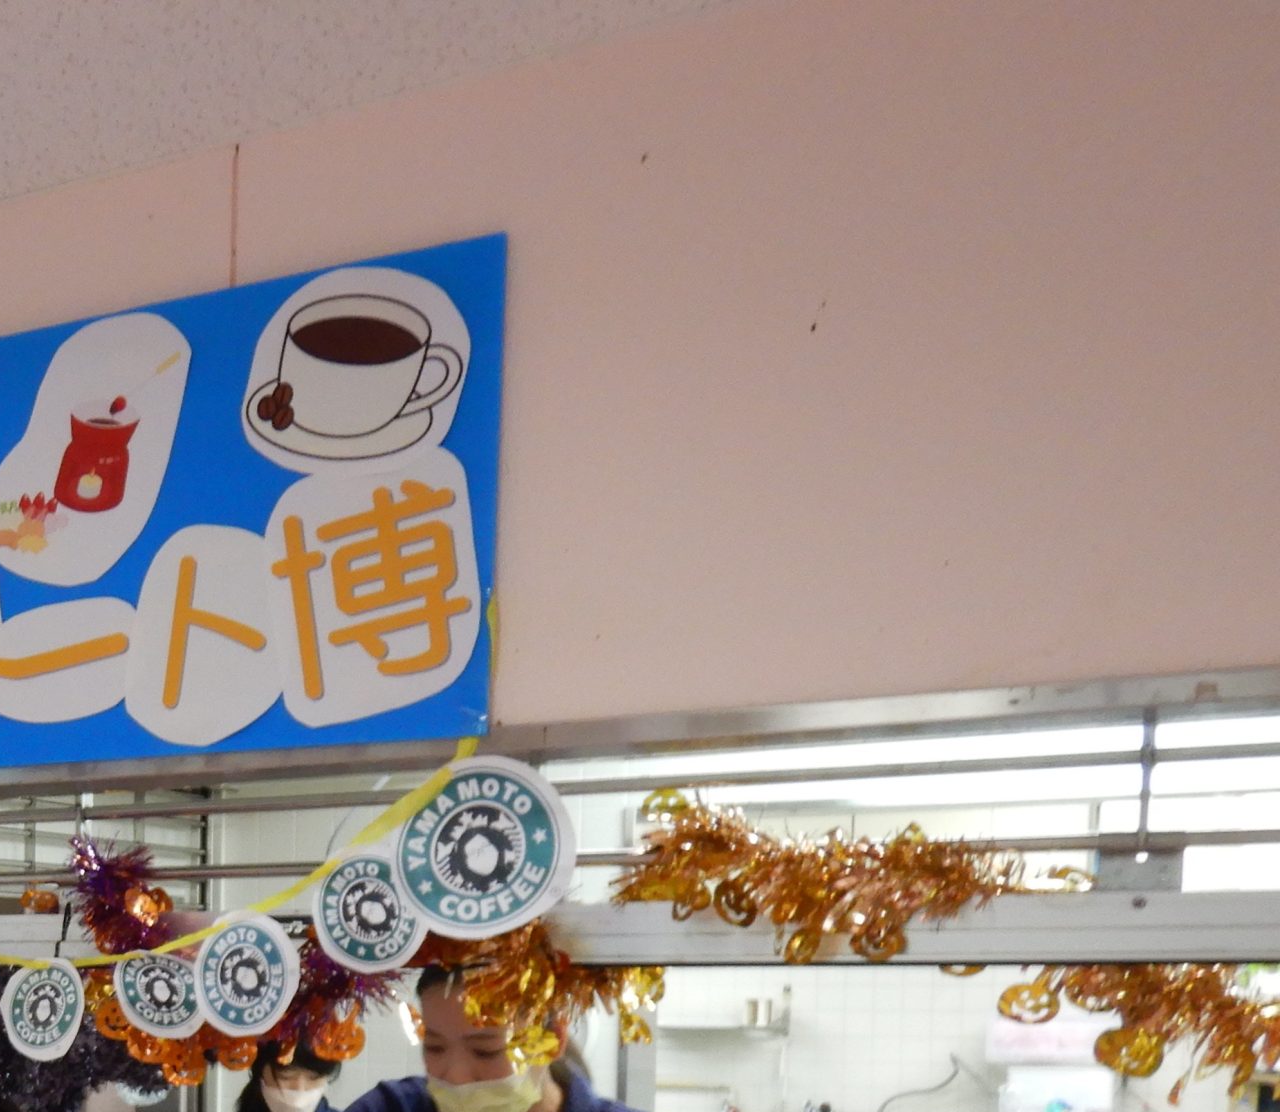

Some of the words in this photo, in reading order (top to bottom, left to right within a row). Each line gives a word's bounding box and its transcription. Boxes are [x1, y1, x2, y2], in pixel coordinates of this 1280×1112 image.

[438, 861, 546, 921] COFFEE
[135, 1001, 191, 1025] COFFEE
[243, 962, 283, 1024] COFFEE
[16, 1020, 61, 1045] COFFEE
